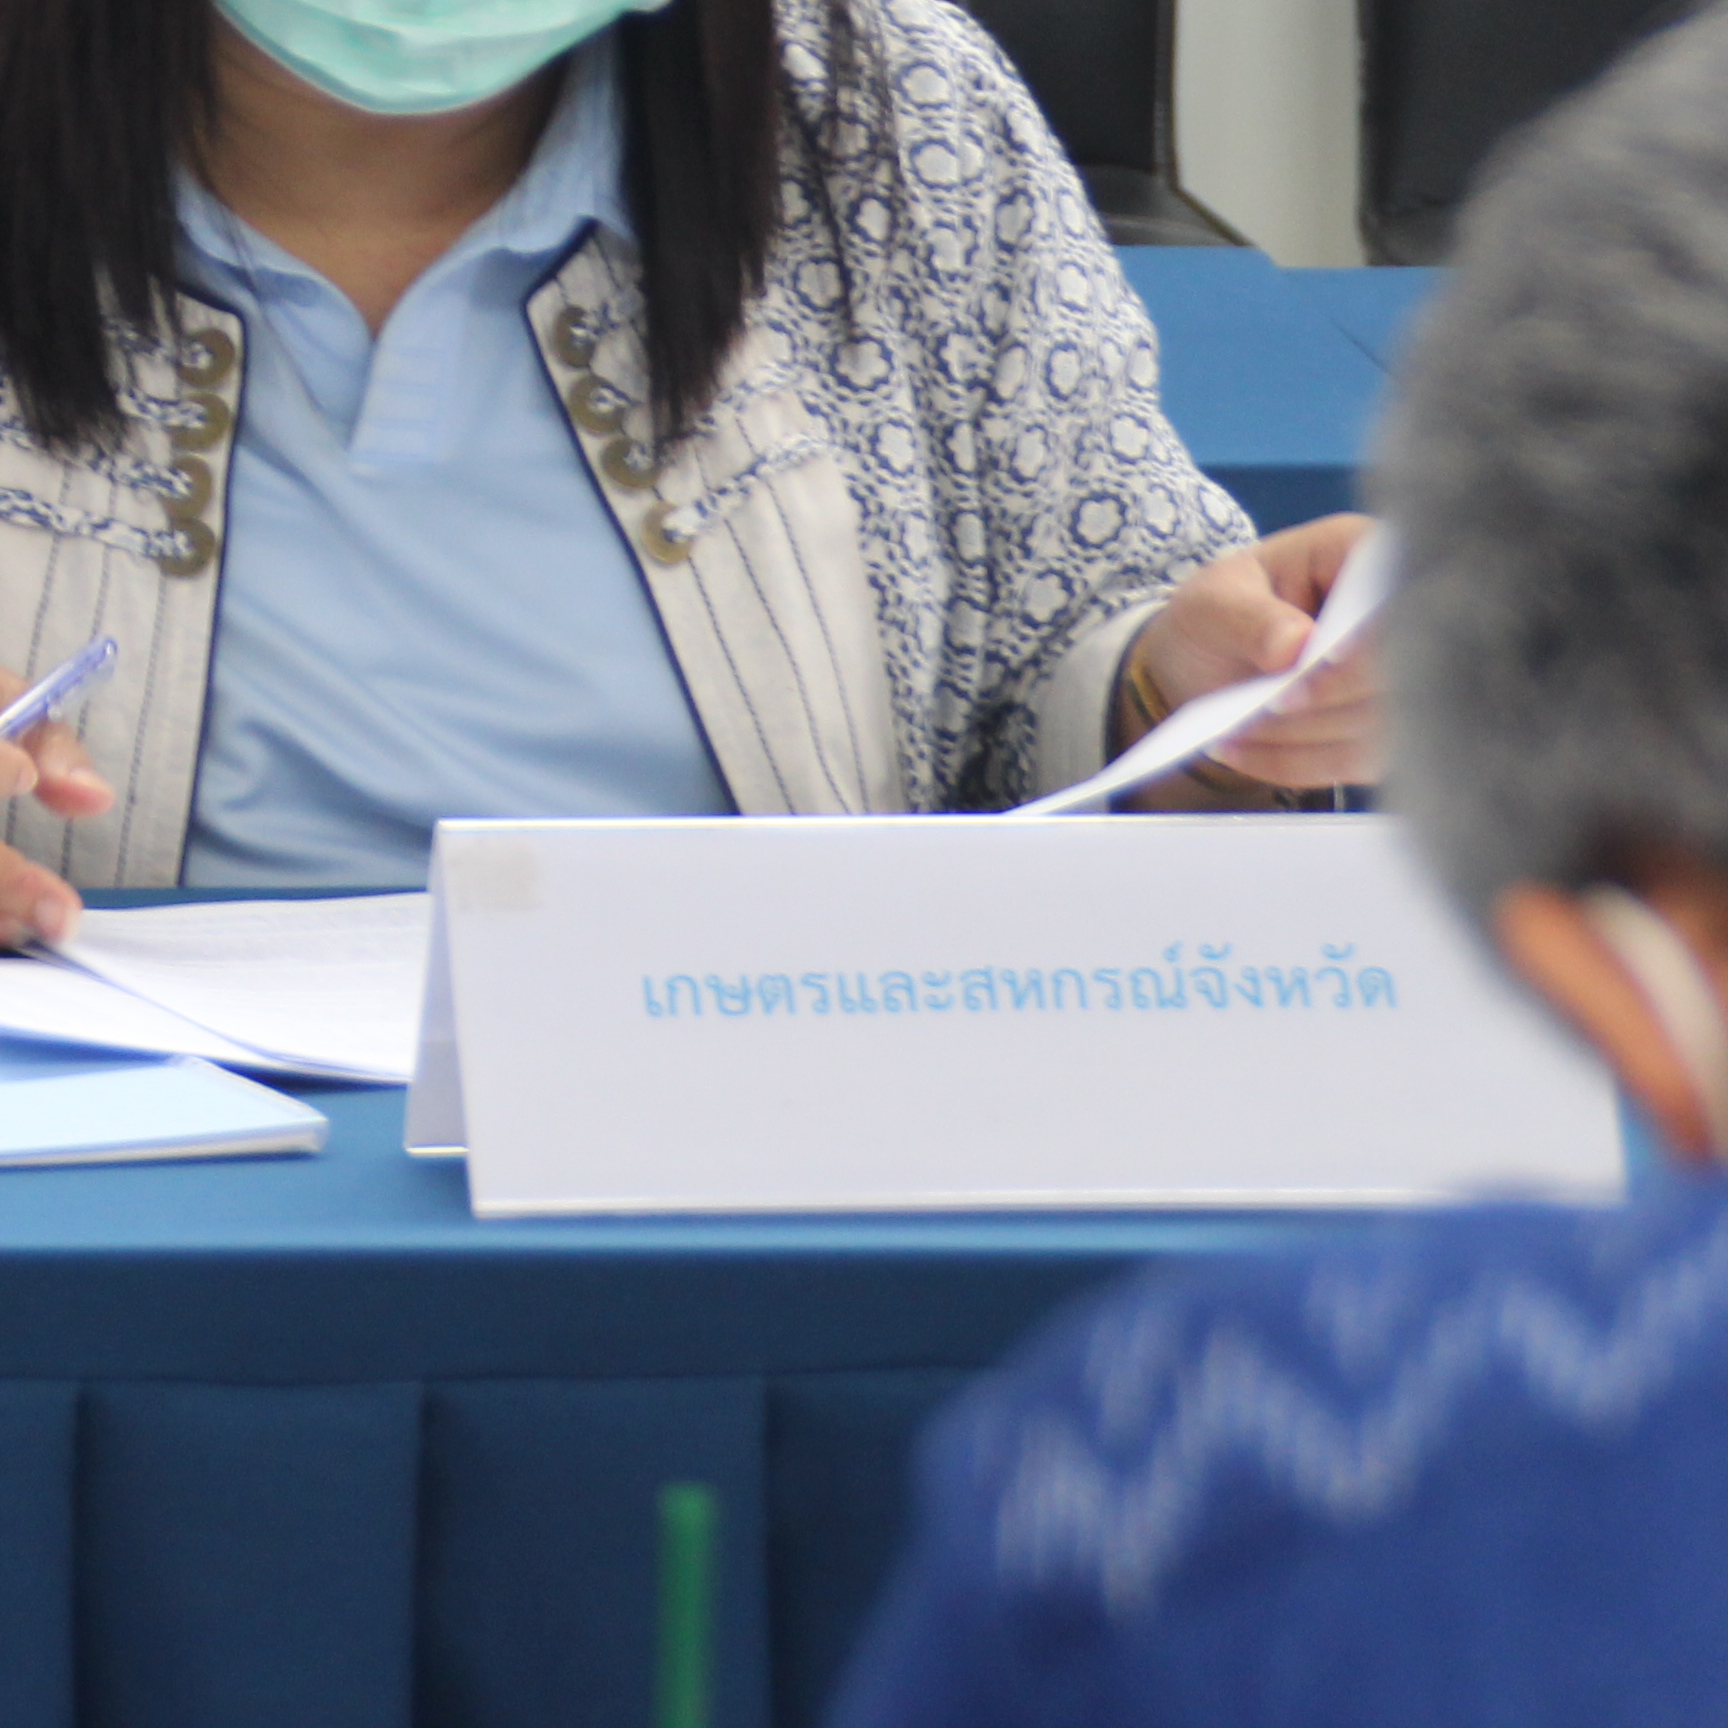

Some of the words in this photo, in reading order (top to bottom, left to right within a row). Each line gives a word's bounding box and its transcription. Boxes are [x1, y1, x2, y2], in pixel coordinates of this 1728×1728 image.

[642, 942, 1397, 1018] เกษตรและสหกรณ์จังหวัด
